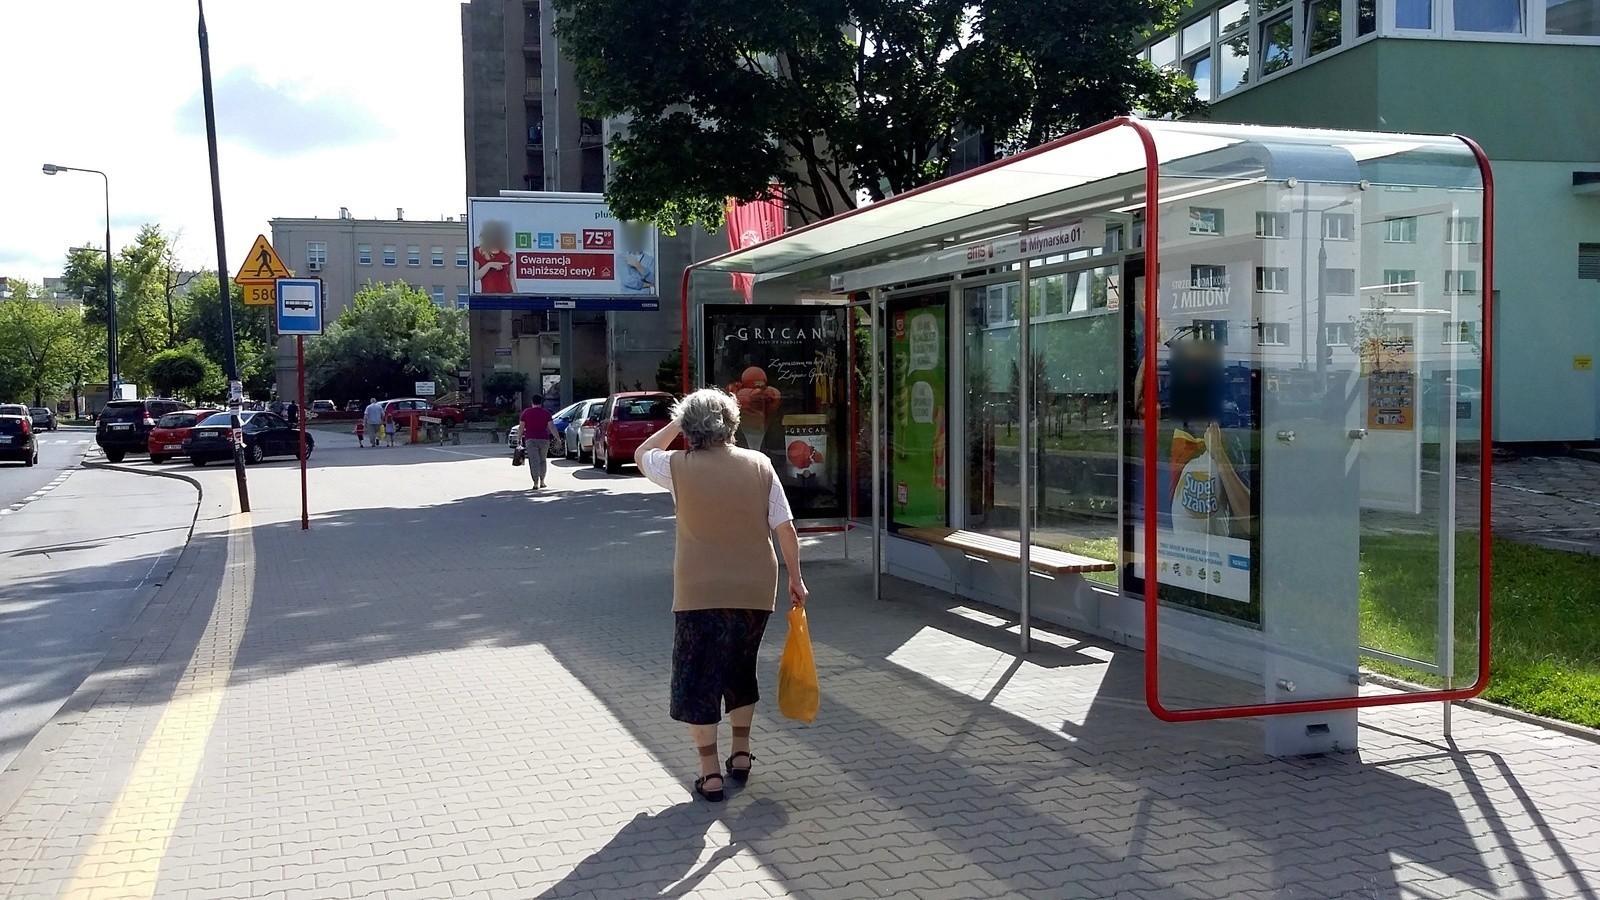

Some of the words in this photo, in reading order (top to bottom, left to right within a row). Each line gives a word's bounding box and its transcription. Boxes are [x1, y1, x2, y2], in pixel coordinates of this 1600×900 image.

[1029, 232, 1070, 252] Młynarska
[1070, 227, 1081, 243] 01
[520, 255, 571, 266] Gwarancja
[967, 245, 986, 260] ams
[520, 265, 568, 277] najniższej
[570, 266, 596, 277] ceny!
[1172, 293, 1178, 309] 2
[1180, 286, 1231, 309] MILIONY
[725, 327, 823, 341] GRYCAN
[1185, 471, 1216, 496] Super
[1182, 489, 1217, 513] Szansa
